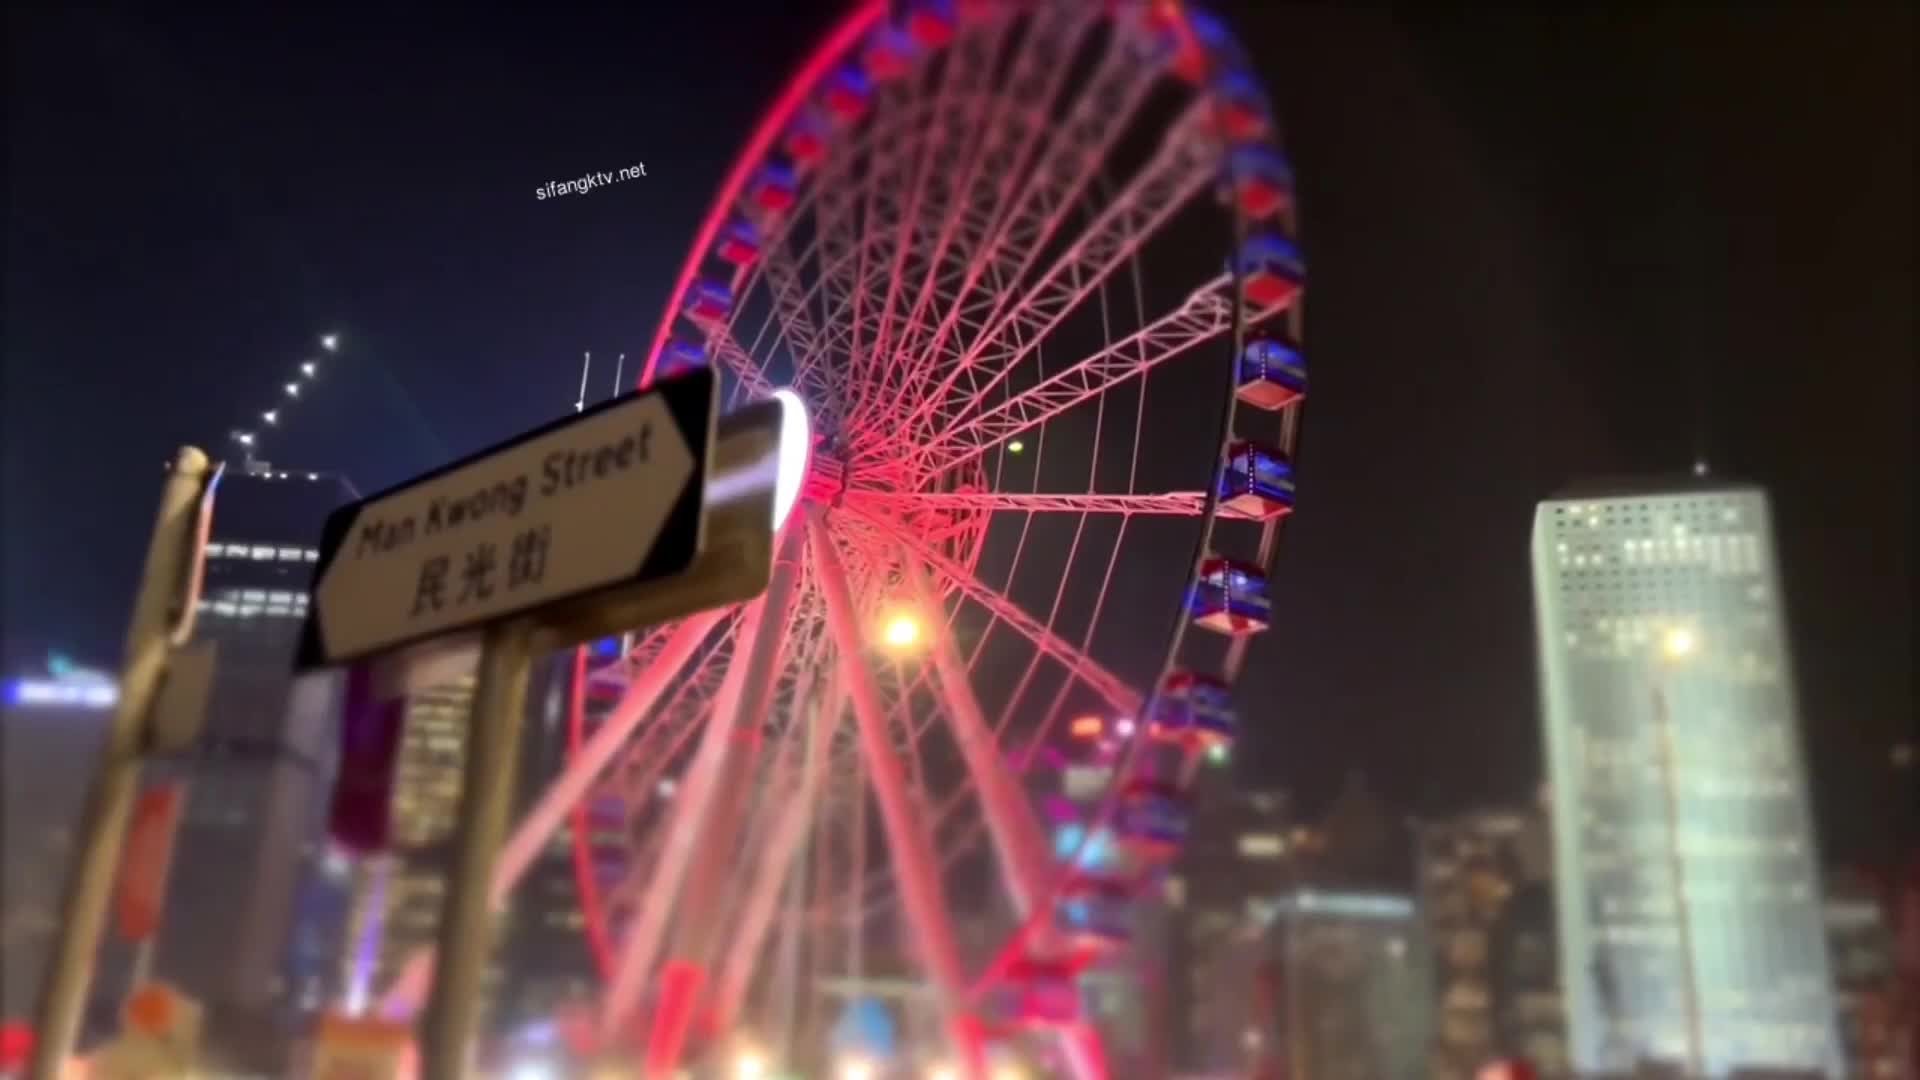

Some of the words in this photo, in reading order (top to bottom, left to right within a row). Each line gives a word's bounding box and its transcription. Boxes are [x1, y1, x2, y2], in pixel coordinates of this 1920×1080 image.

[358, 517, 415, 558] Man
[426, 476, 528, 532] Kwong
[542, 423, 653, 496] Street
[412, 525, 551, 612] 民光街
